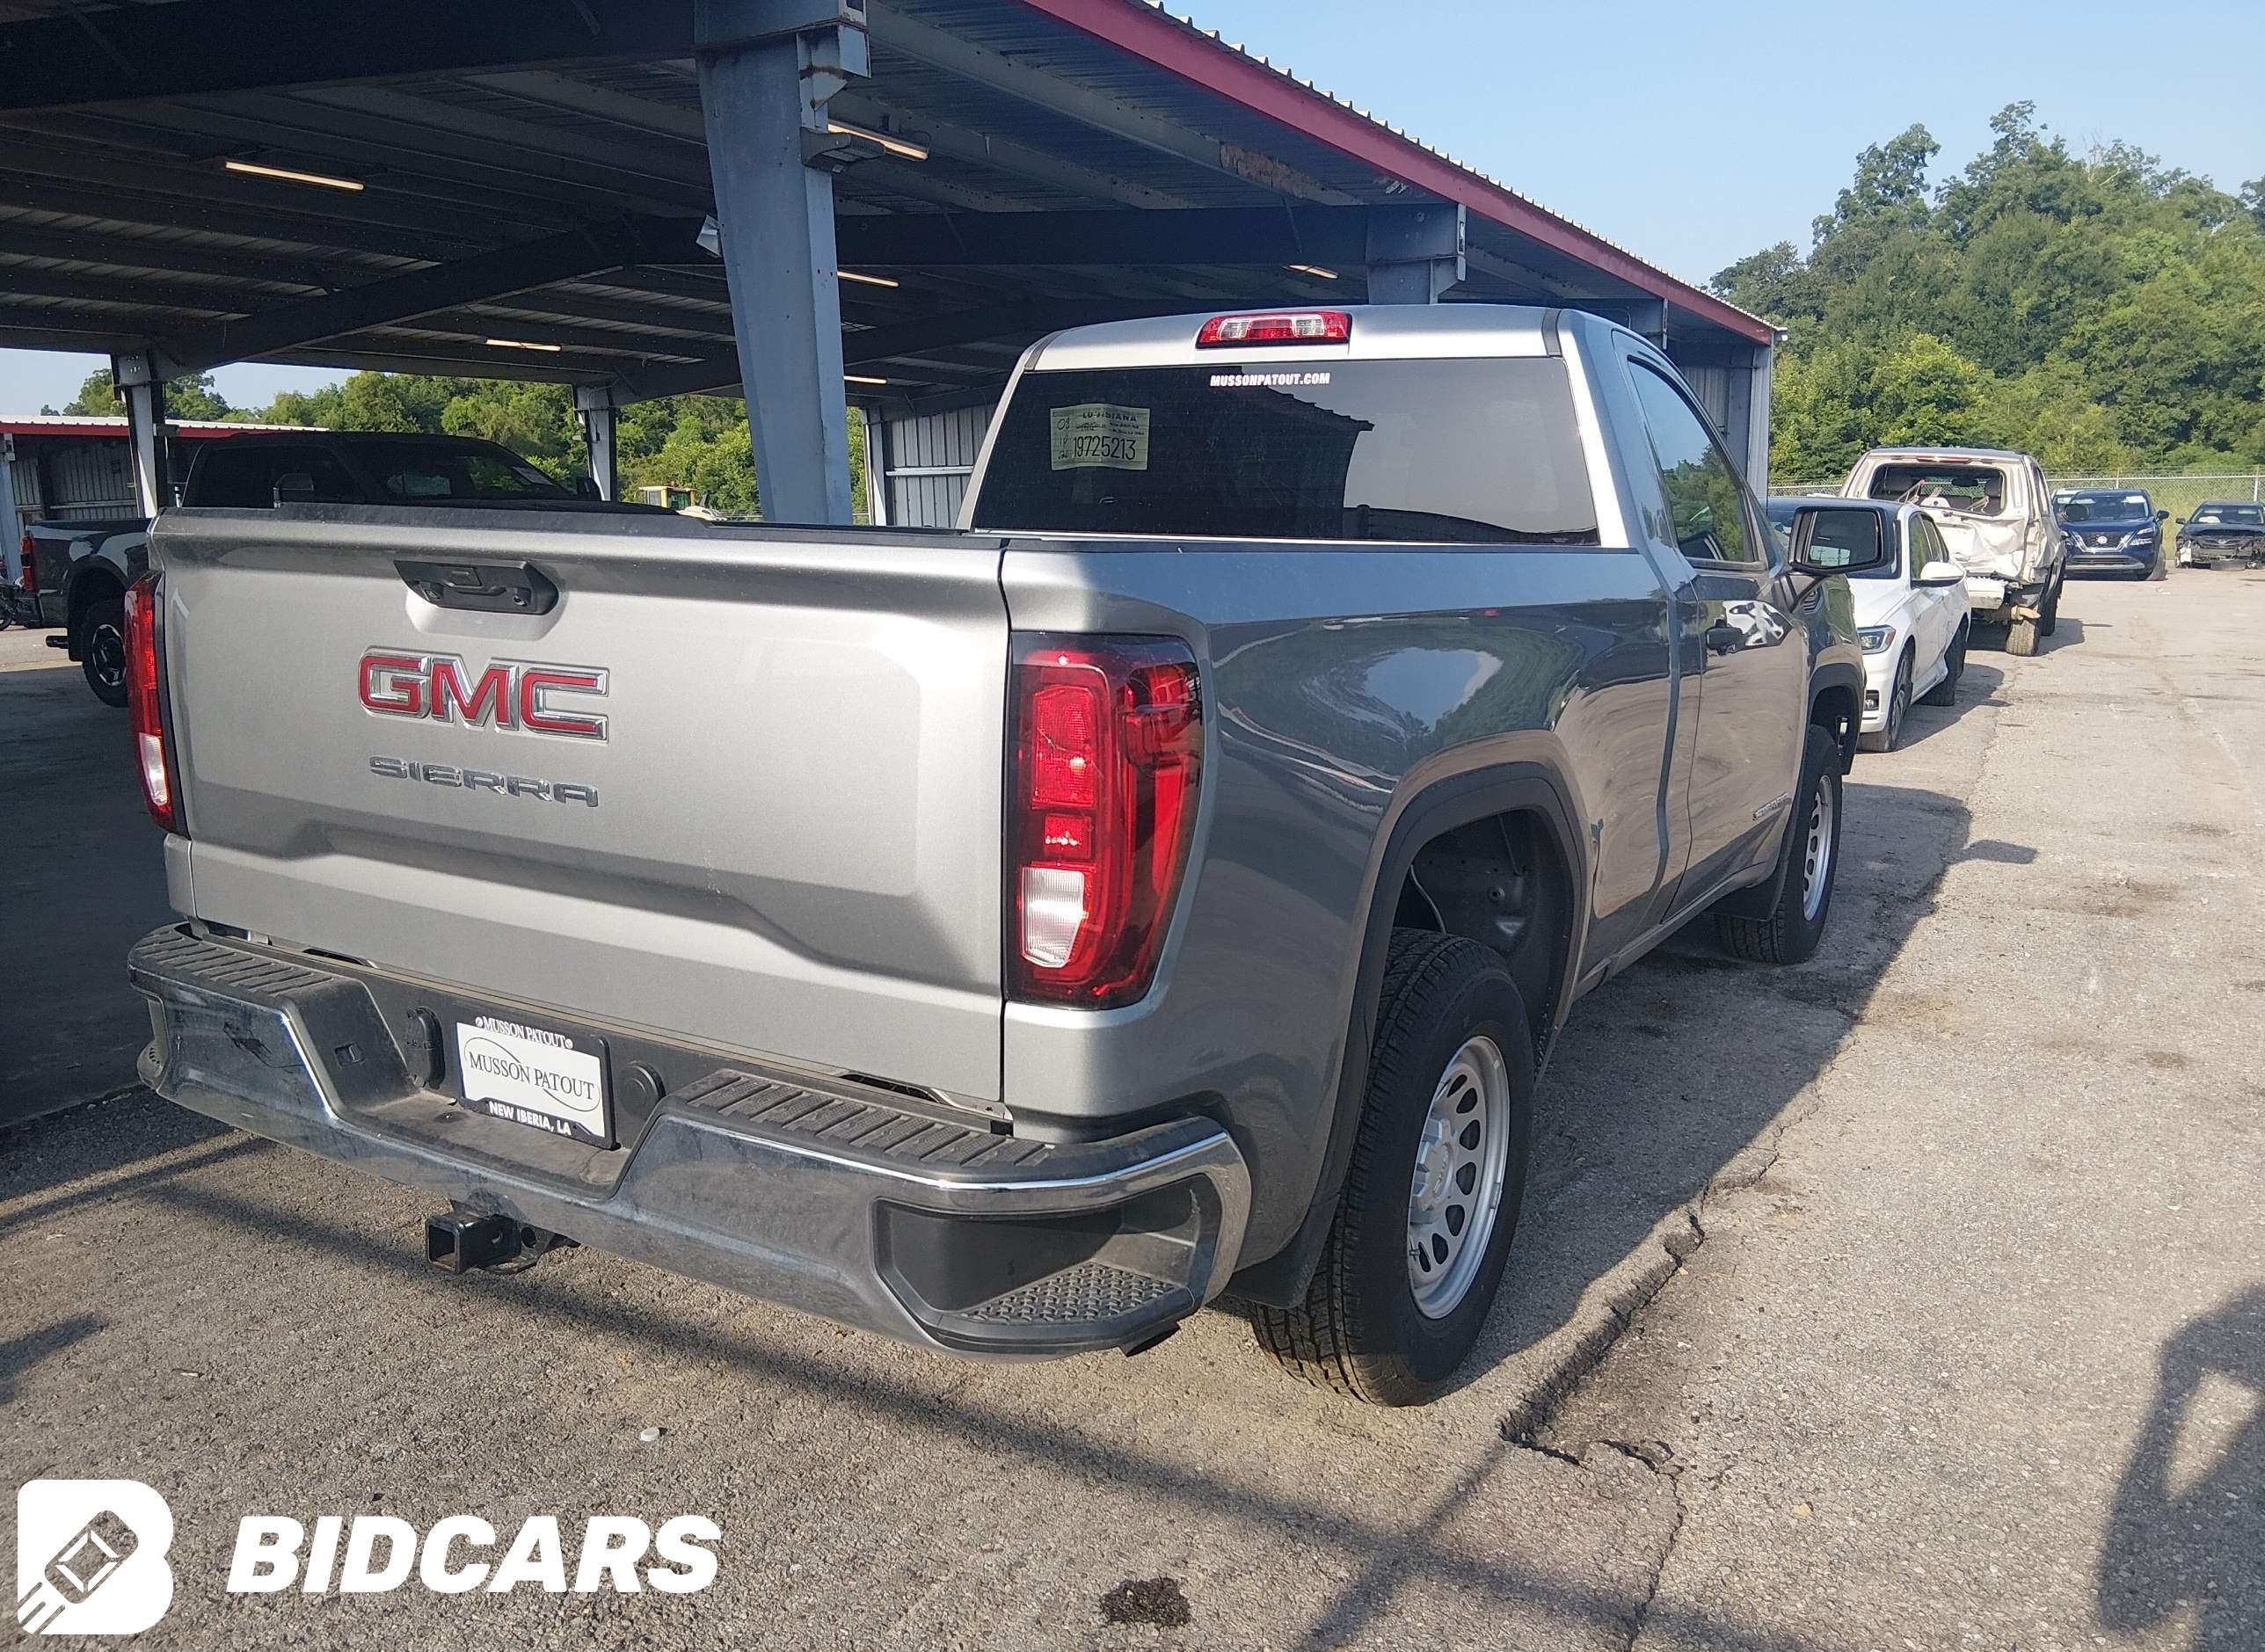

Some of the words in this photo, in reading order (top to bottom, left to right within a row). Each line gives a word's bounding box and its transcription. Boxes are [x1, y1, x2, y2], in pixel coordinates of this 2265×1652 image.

[1210, 373, 1330, 387] MUSSONPATOUT.COM
[1073, 435, 1137, 461] 19725213
[358, 645, 610, 745] GMC
[369, 756, 599, 808] SIERRA
[482, 1016, 525, 1039] MUSSON
[527, 1026, 566, 1047] PATOUT
[469, 1051, 530, 1084] MUSSON
[534, 1068, 594, 1100] PATOUT
[489, 1101, 514, 1120] NEW
[516, 1108, 555, 1132] IBERIA,
[557, 1120, 572, 1135] LA
